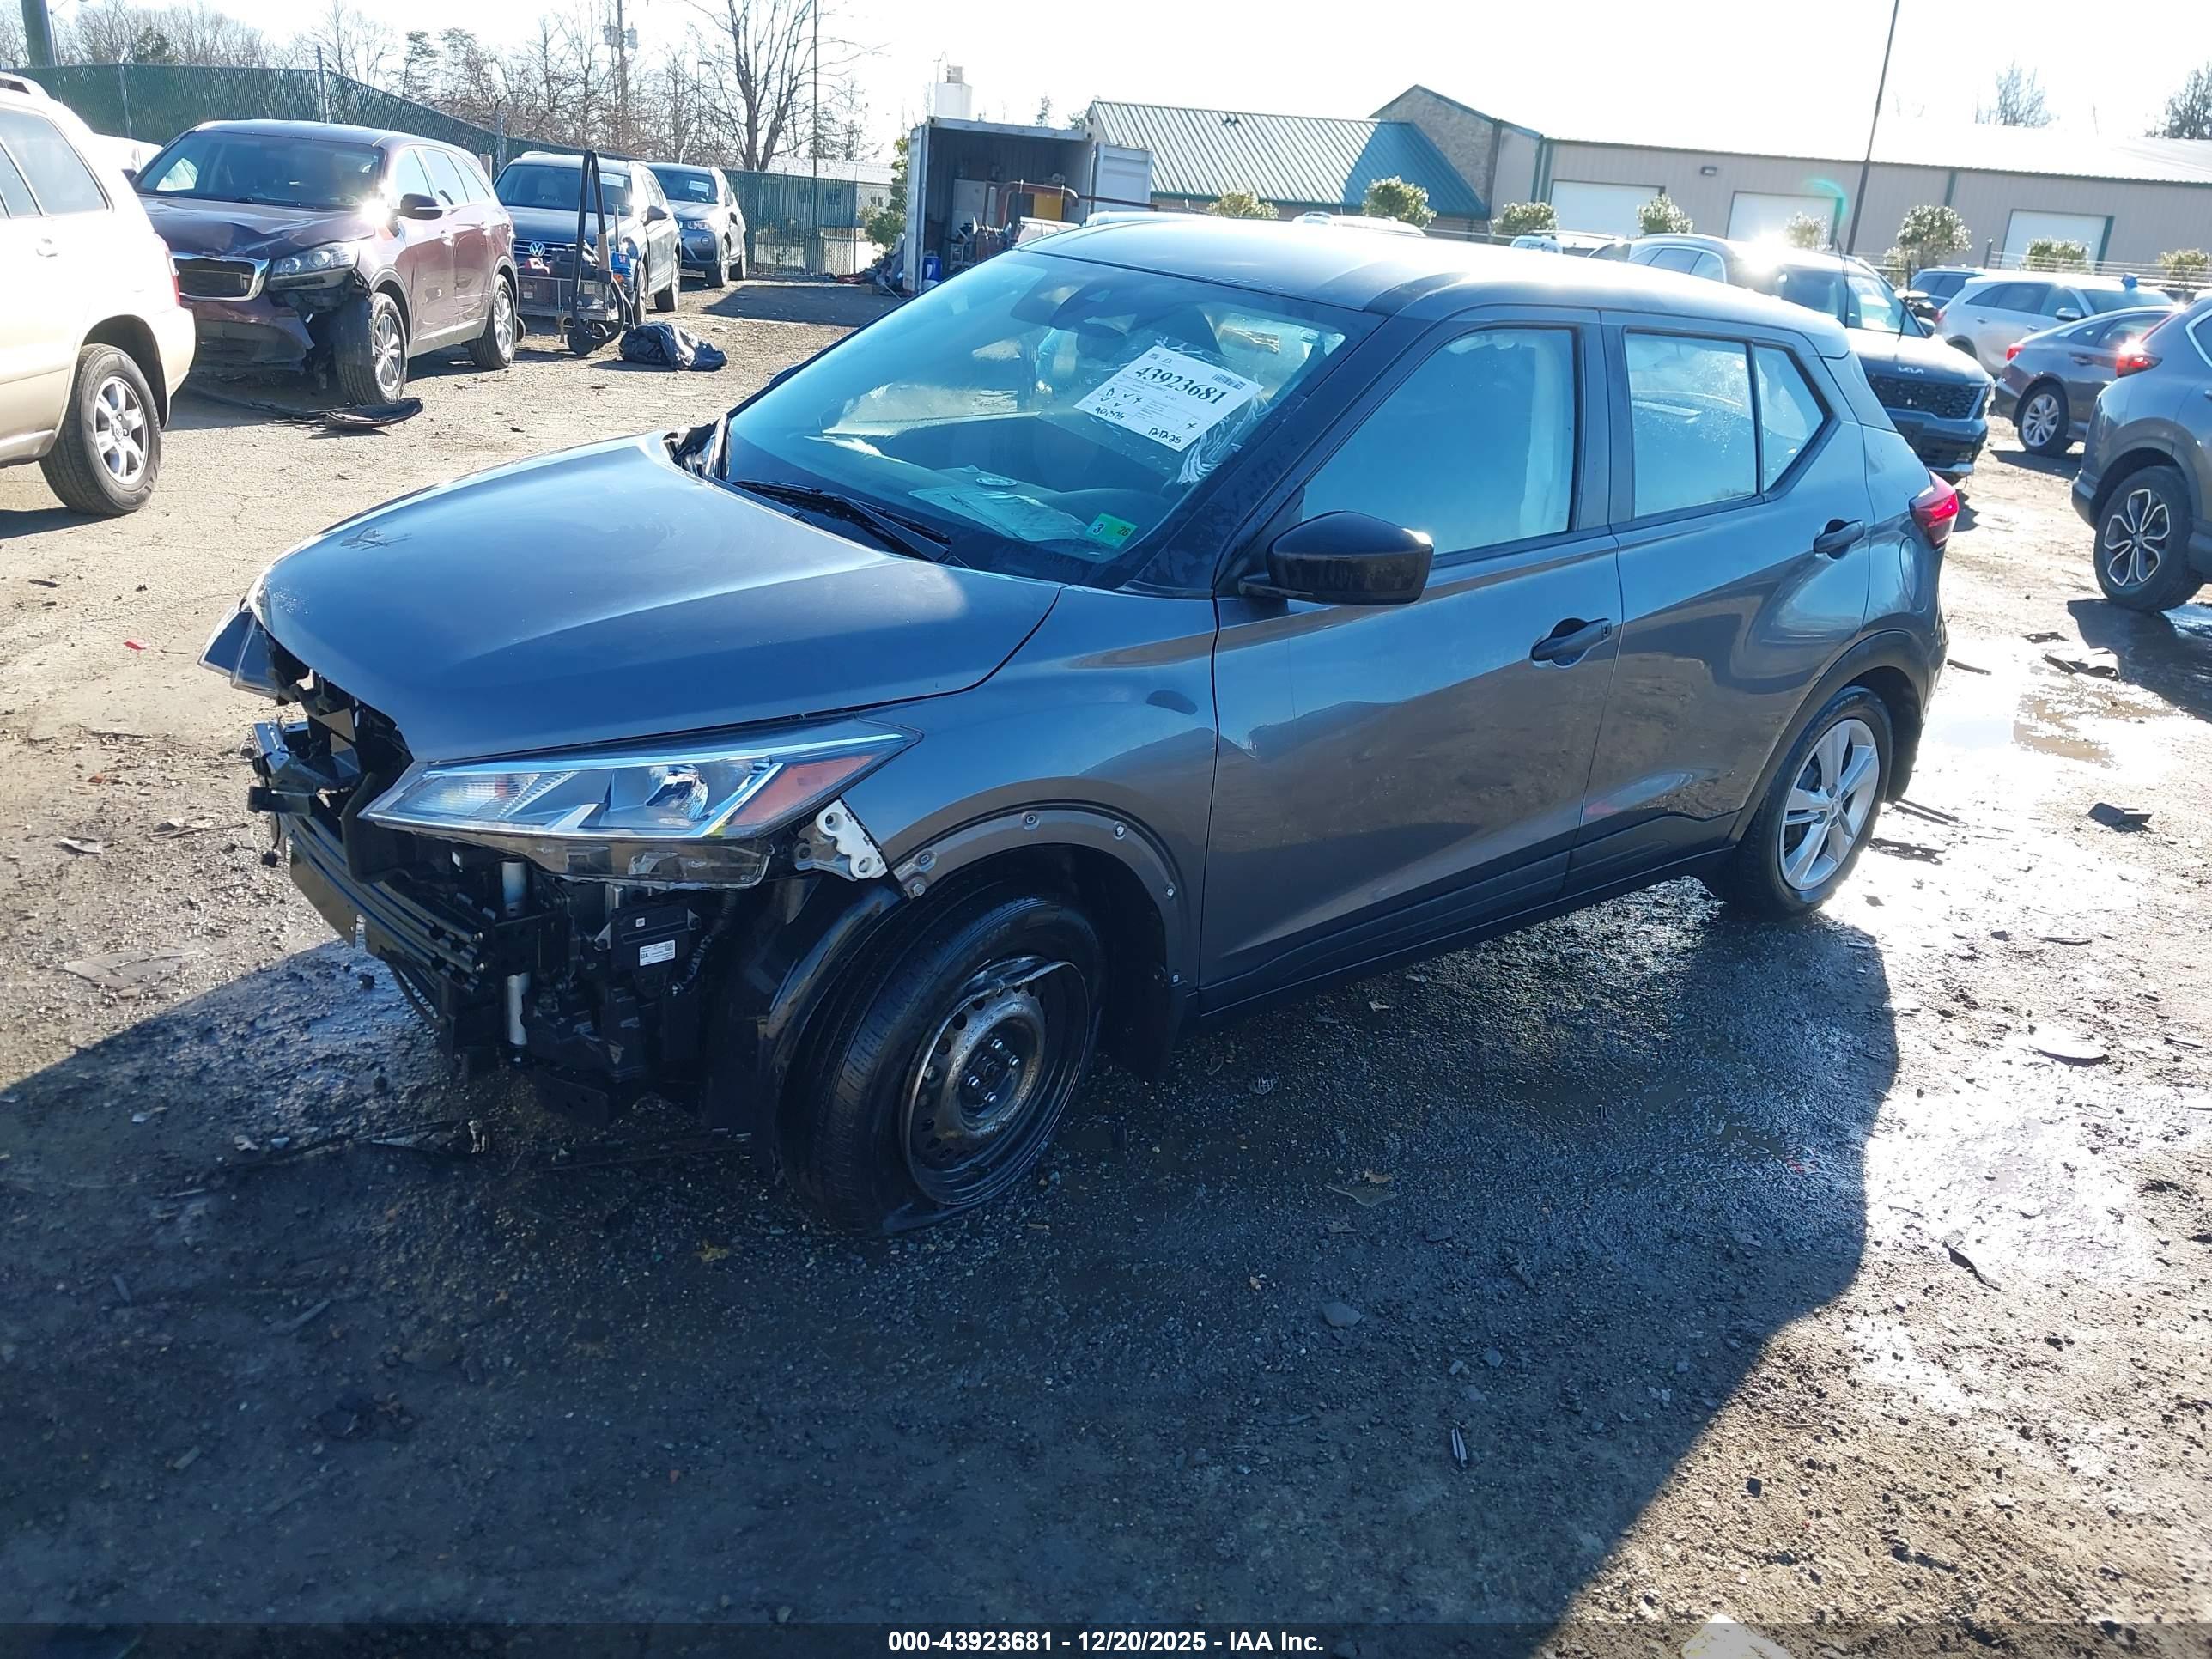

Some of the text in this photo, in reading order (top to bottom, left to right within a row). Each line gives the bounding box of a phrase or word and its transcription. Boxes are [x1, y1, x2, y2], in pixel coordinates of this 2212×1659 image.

[1135, 366, 1228, 405] 43923681
[1093, 523, 1131, 537] 3 26
